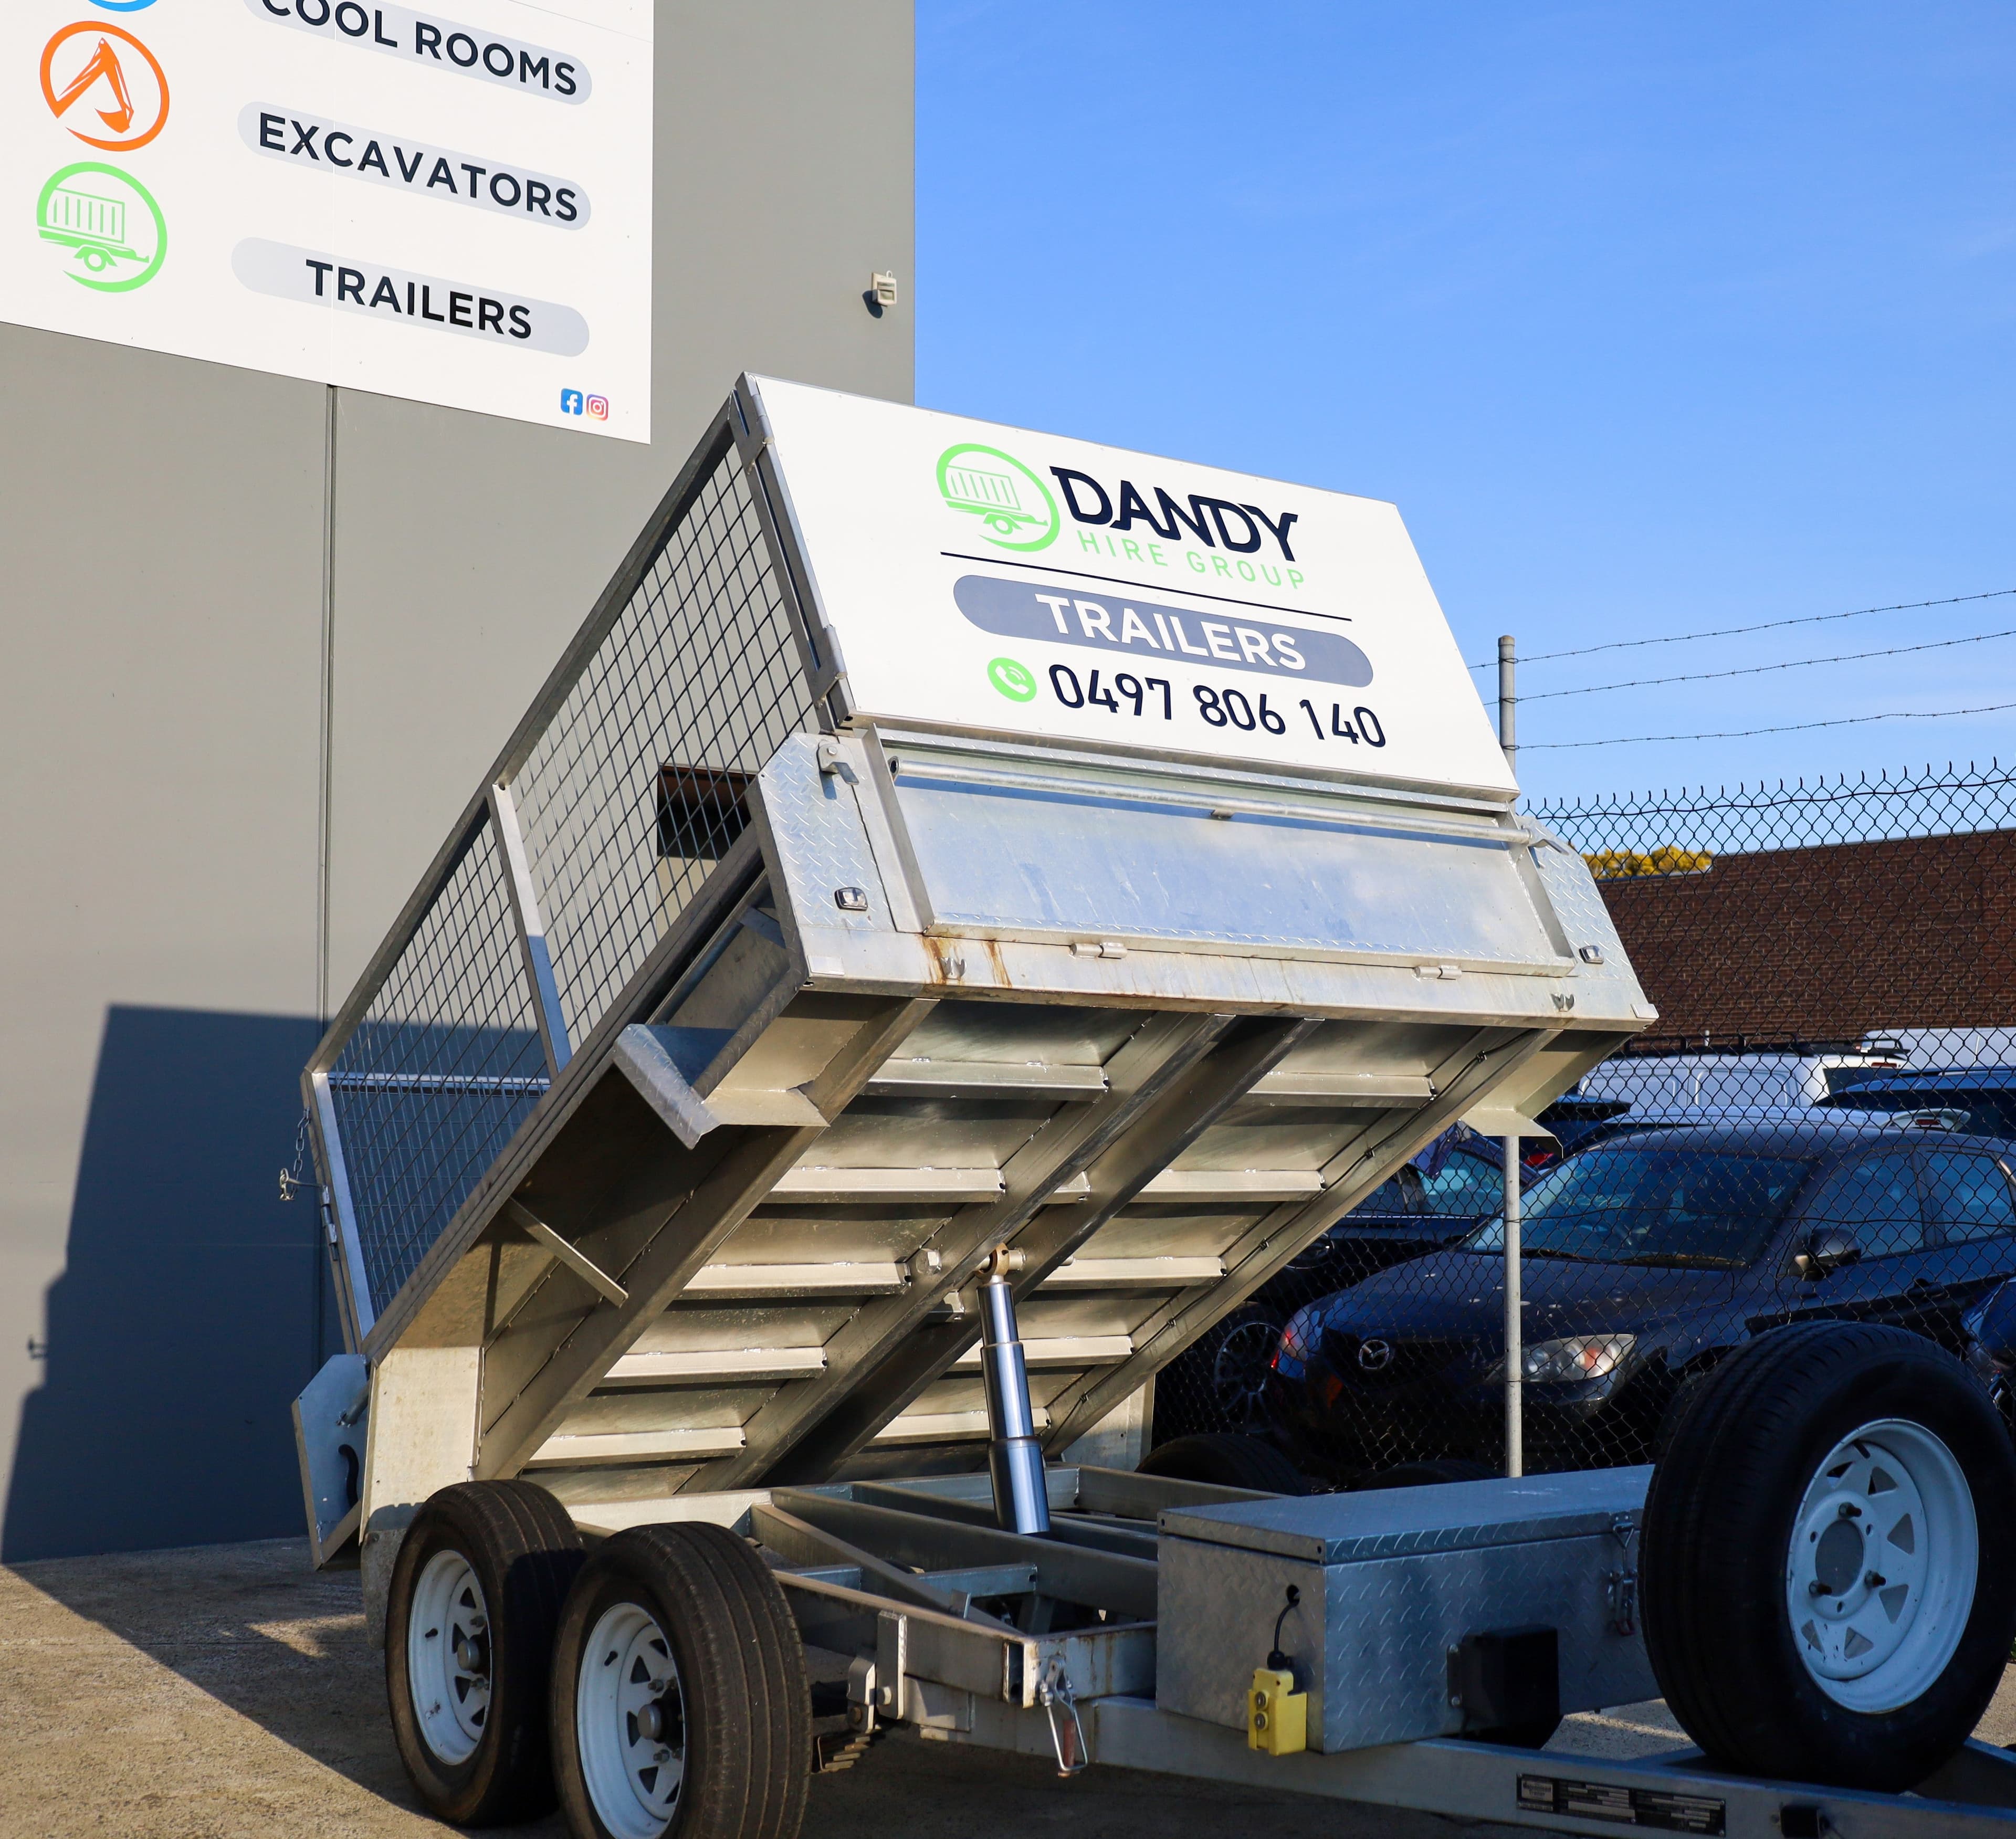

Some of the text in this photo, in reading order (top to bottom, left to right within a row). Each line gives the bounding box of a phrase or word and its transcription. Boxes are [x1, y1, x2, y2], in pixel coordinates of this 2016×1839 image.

[414, 21, 577, 96] ROOMS
[260, 112, 578, 222] EXCAVATORS
[306, 259, 532, 340] TRAILERS
[1048, 466, 1298, 562] DANDY
[1077, 530, 1304, 589] HIRE GROUP
[1035, 593, 1306, 671] TRAILERS
[1048, 664, 1387, 748] 0497 806 140
